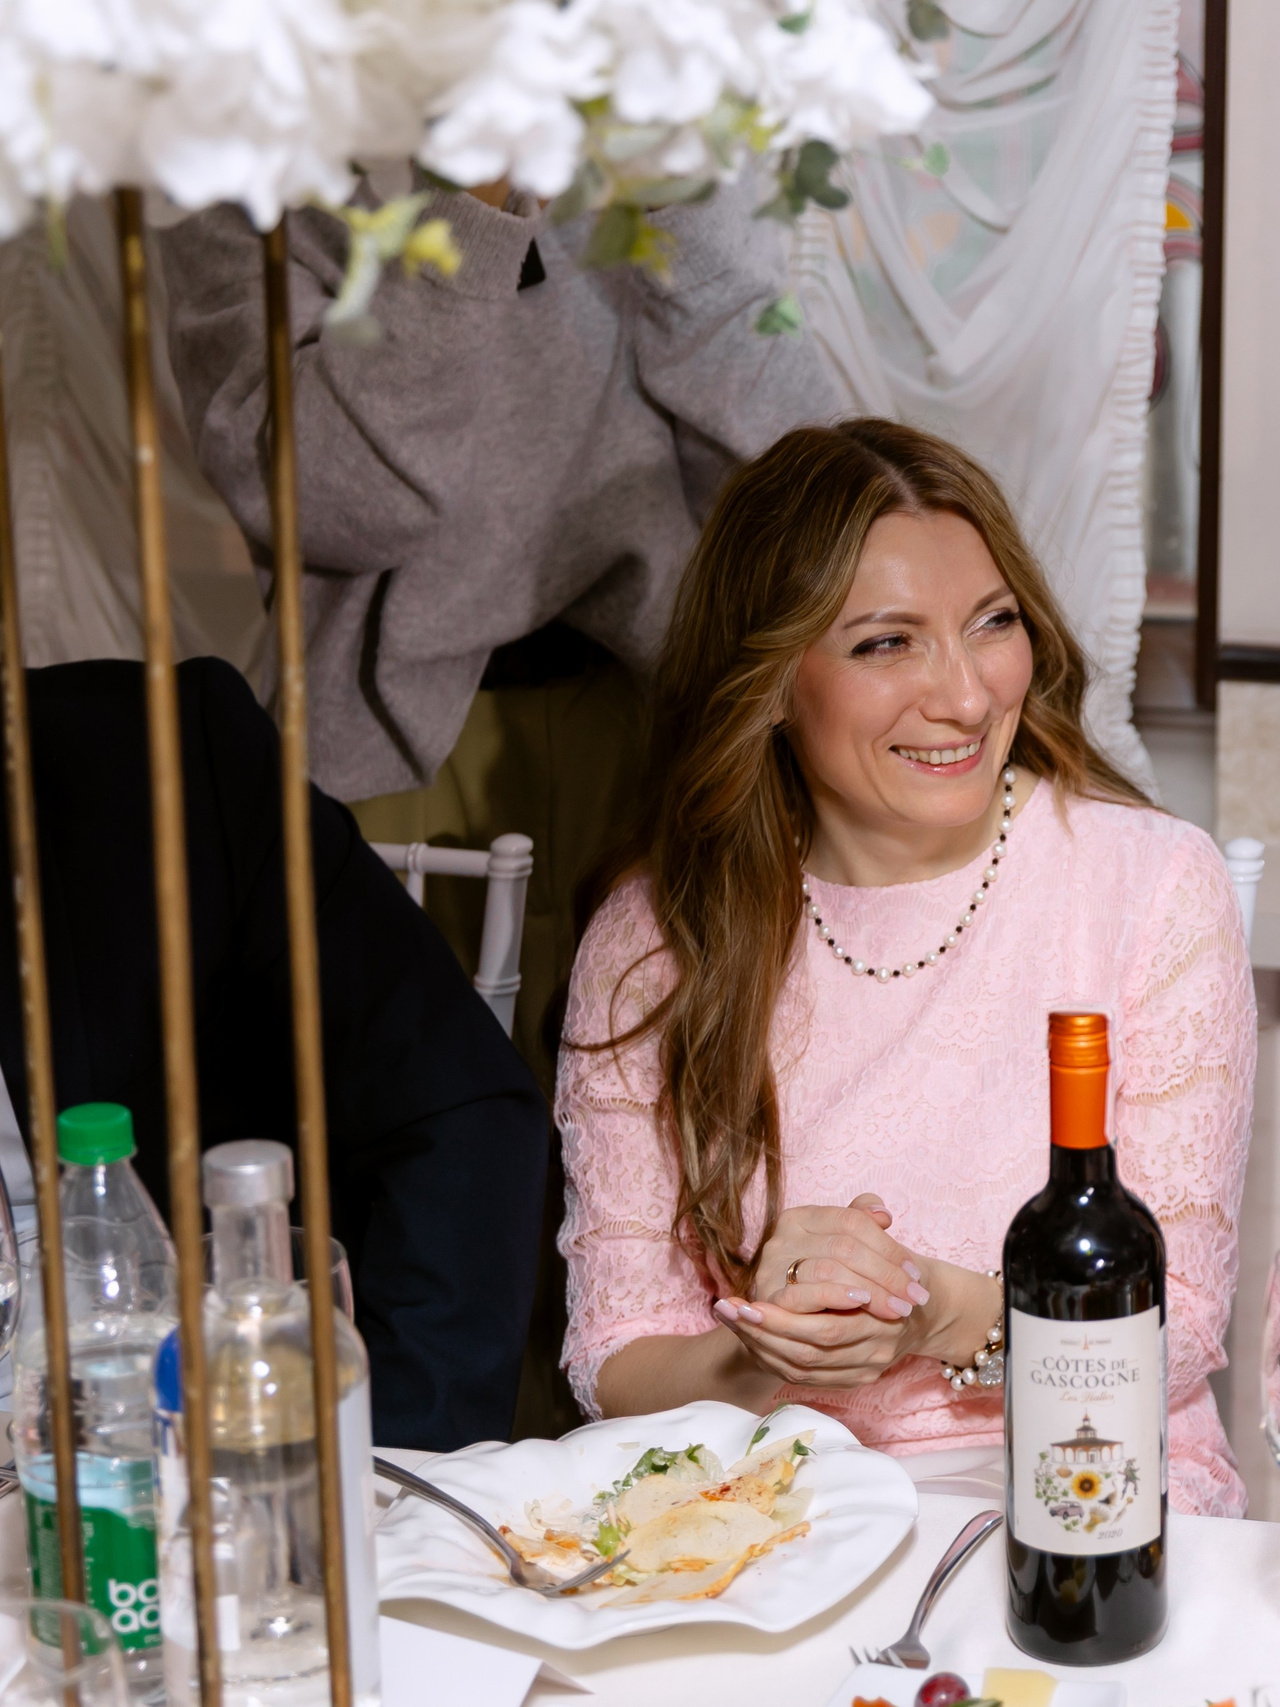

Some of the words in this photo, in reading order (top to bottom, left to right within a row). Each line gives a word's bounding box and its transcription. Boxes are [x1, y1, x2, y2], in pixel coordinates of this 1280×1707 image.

[1042, 1355, 1106, 1373] CÔTES
[1111, 1358, 1128, 1371] DE
[1031, 1367, 1140, 1389] GASCOGNE
[1097, 1528, 1124, 1540] 2020
